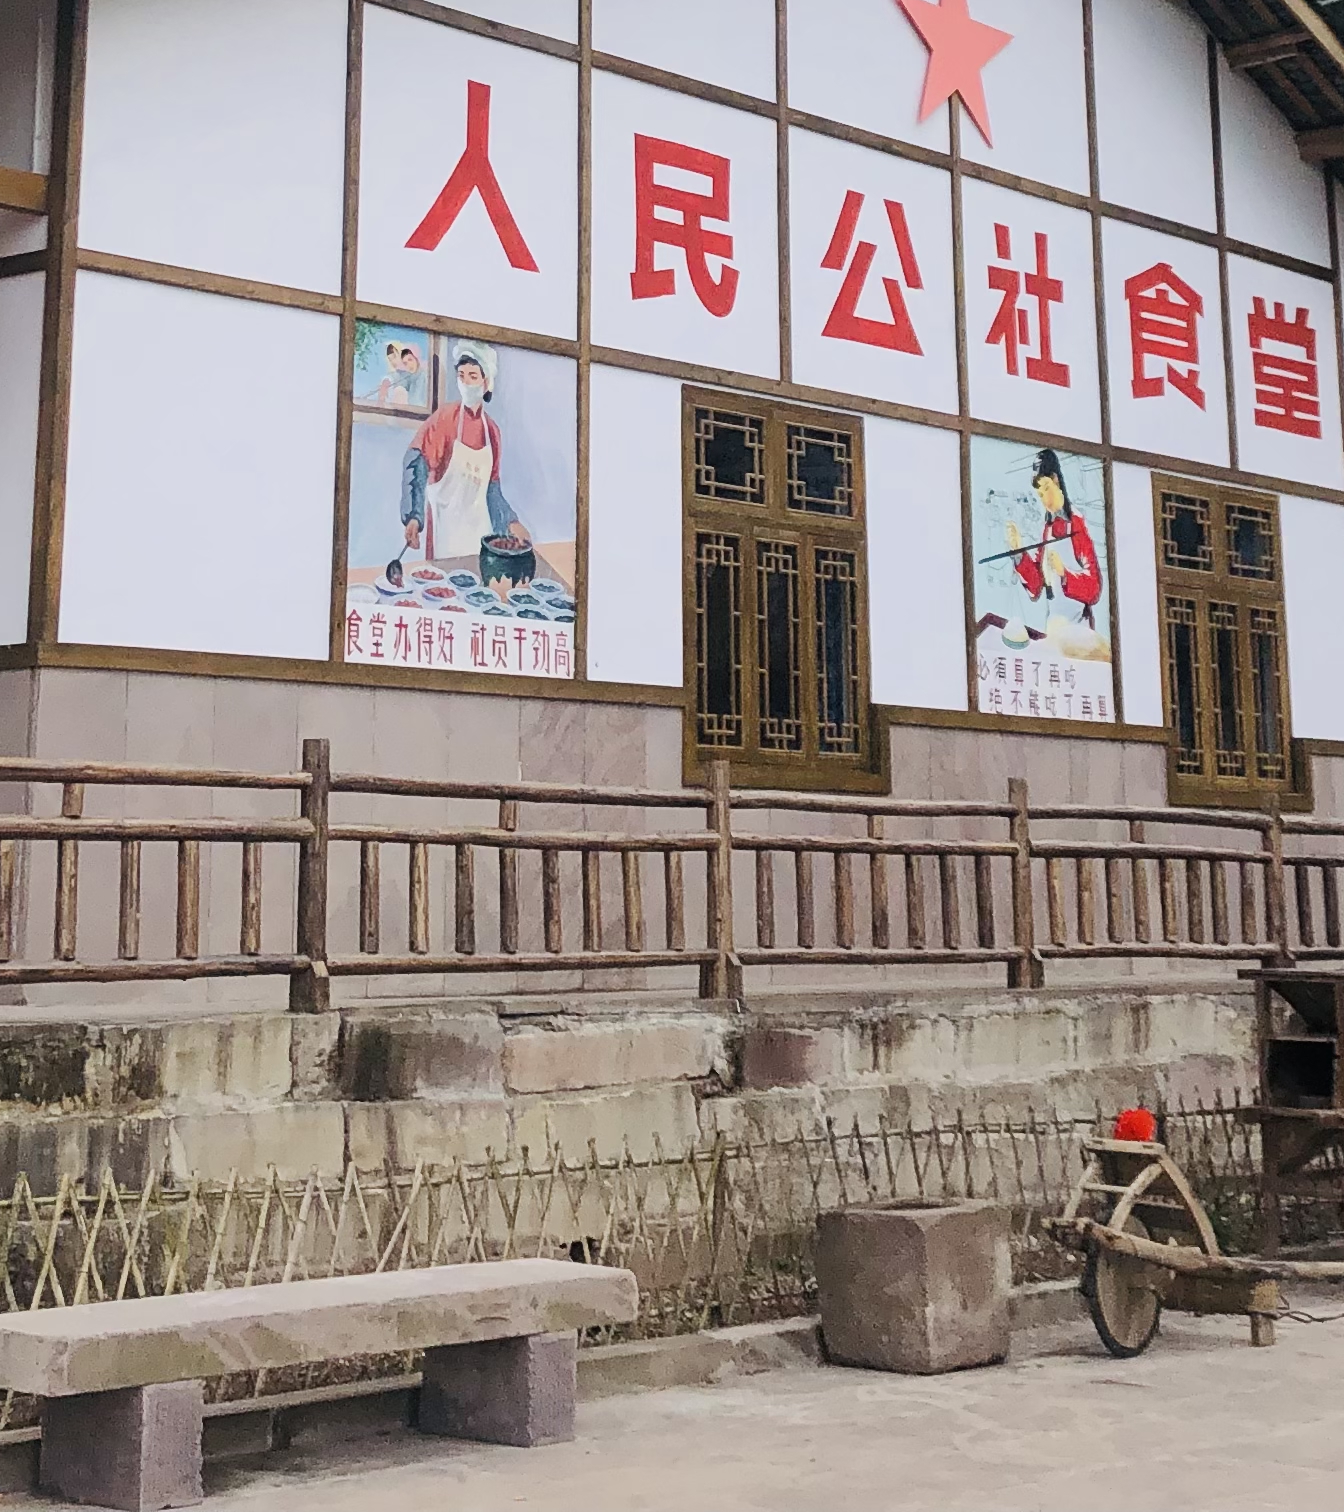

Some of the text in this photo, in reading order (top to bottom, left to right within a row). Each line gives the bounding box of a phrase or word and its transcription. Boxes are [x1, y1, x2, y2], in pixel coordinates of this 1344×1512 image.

[404, 79, 1323, 440] 人民公社食堂
[346, 609, 571, 677] 食堂办得好 社员干劲高
